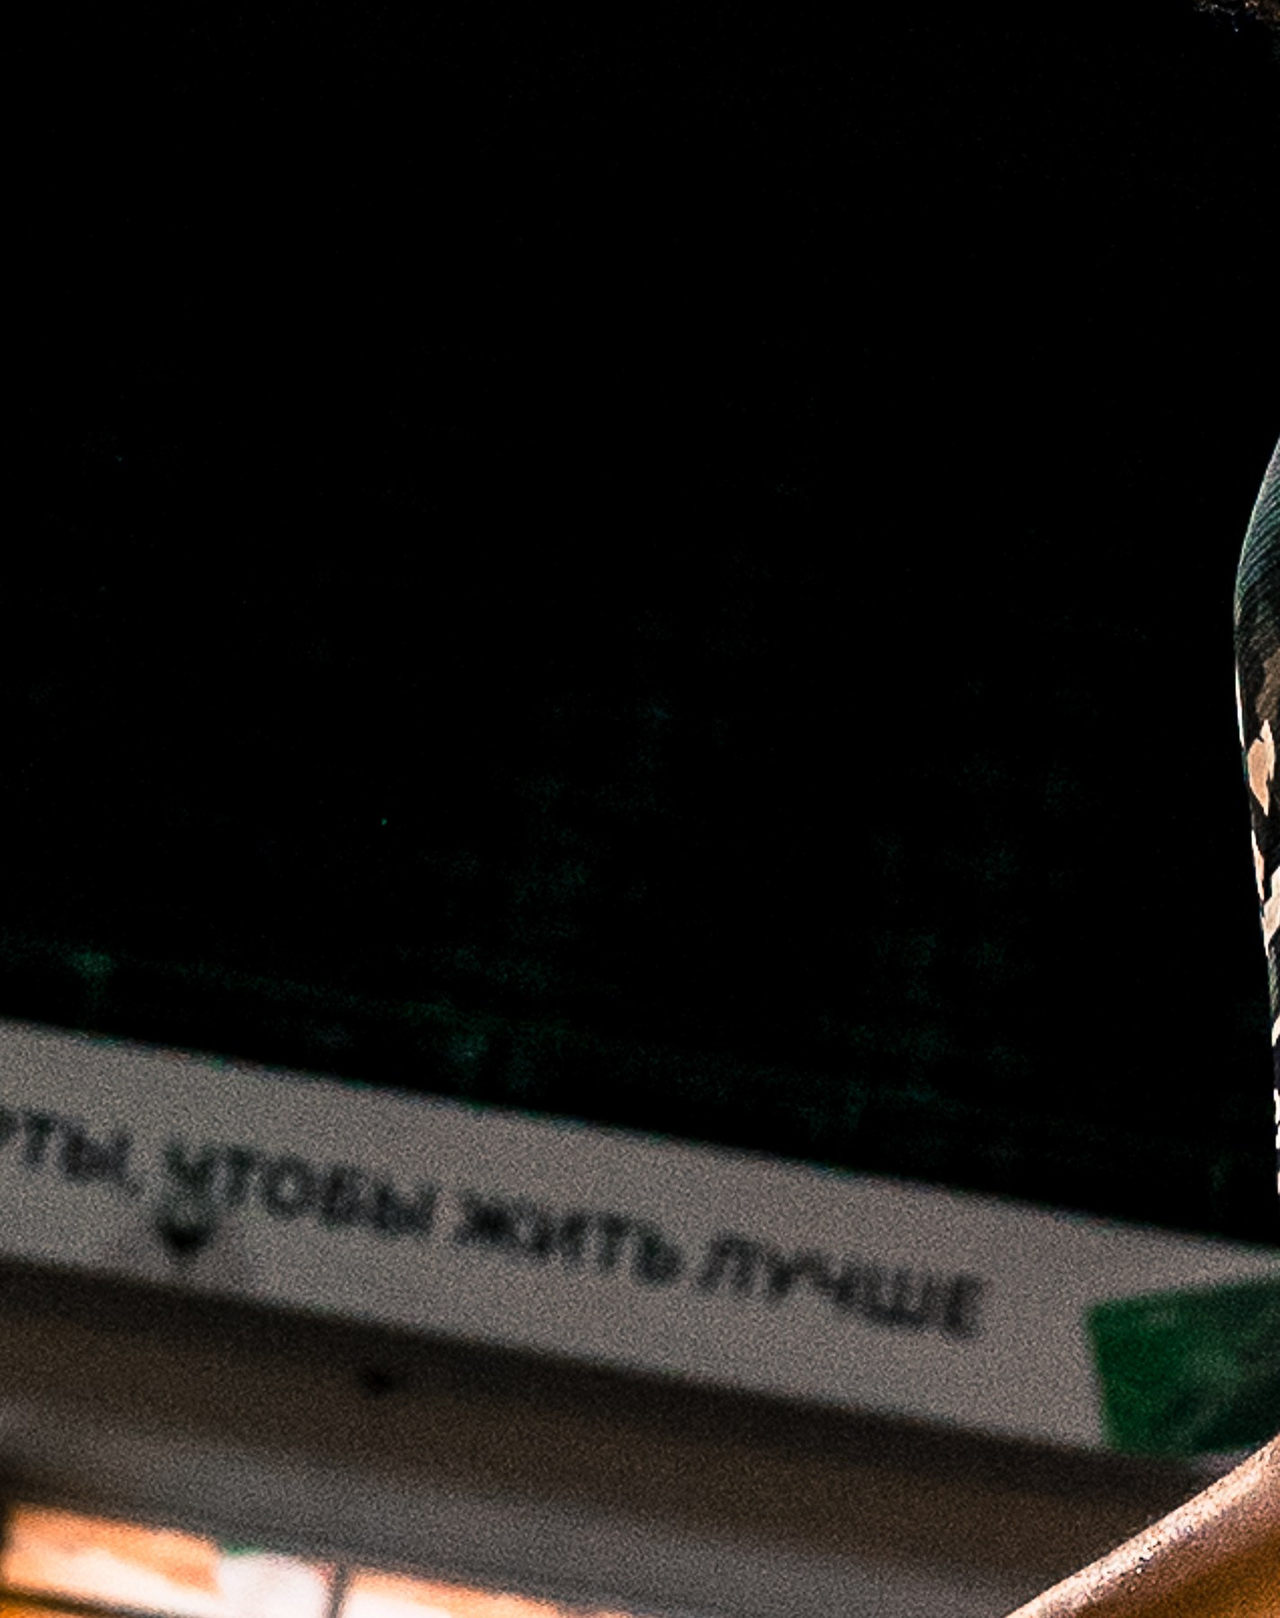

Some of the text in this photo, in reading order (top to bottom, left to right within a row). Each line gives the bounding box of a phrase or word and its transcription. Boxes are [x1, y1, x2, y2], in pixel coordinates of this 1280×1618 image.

[163, 1143, 438, 1236] ЧТОБЫ
[455, 1193, 682, 1284] ЖИТЬ
[698, 1231, 984, 1339] ЛУЧШЕ
